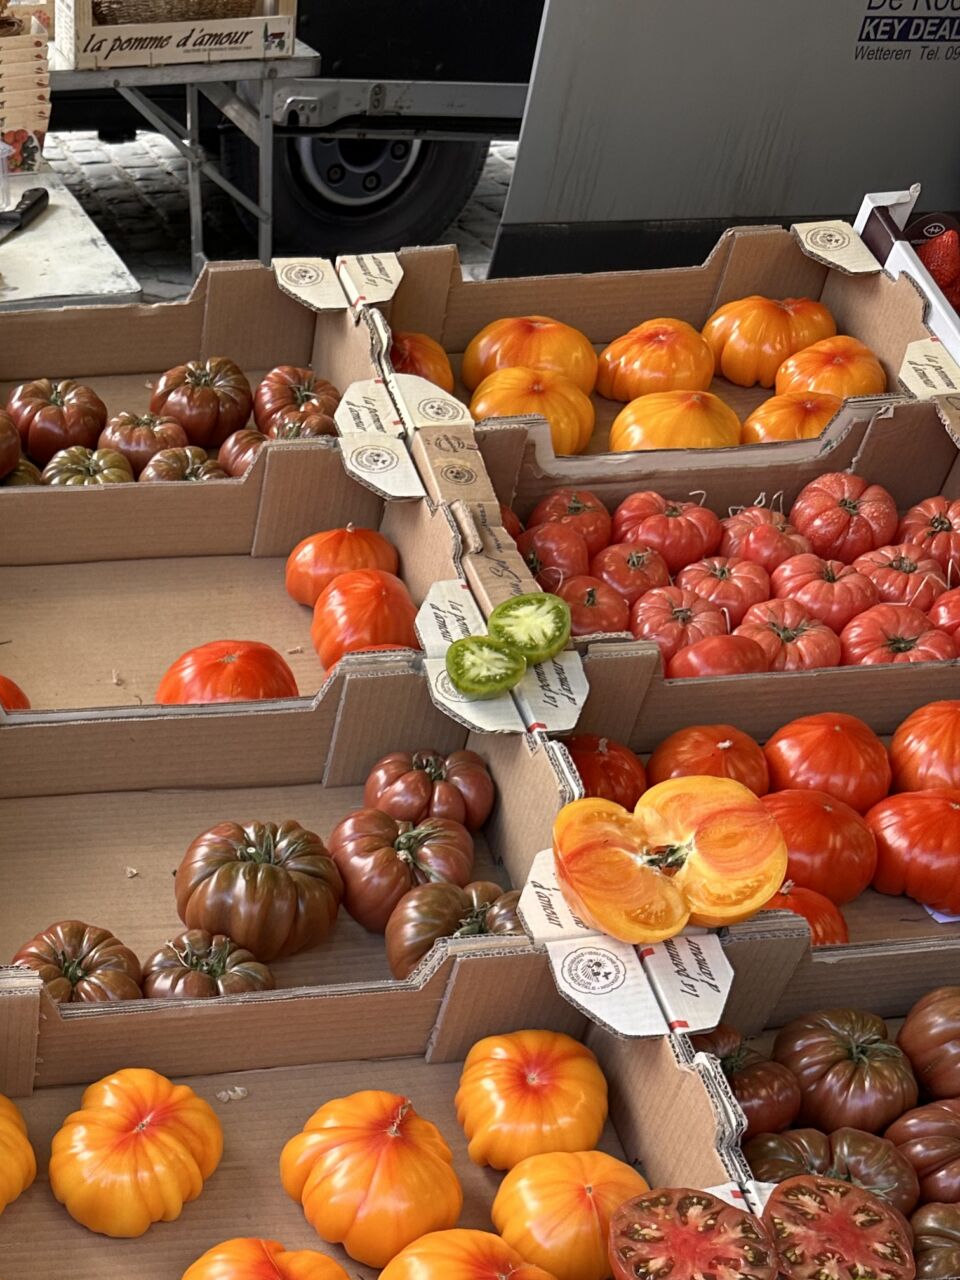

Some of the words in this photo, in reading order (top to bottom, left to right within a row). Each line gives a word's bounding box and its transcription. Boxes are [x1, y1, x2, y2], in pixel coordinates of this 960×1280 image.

[861, 18, 907, 40] KEY
[83, 33, 108, 53] la
[104, 35, 173, 60] pomme
[176, 28, 254, 49] d'amour
[855, 46, 912, 60] Wetteren
[924, 354, 939, 363] la
[907, 360, 938, 390] d'amour
[923, 361, 958, 391] pomme
[362, 395, 376, 407] la
[346, 400, 367, 432] d'amour
[360, 404, 387, 434] pomme
[448, 600, 464, 615] la
[447, 611, 472, 637] pom
[543, 692, 559, 708] la
[530, 880, 564, 929] d'amour
[663, 938, 699, 982] pomm
[685, 937, 722, 994] d'amour
[679, 981, 700, 998] la
